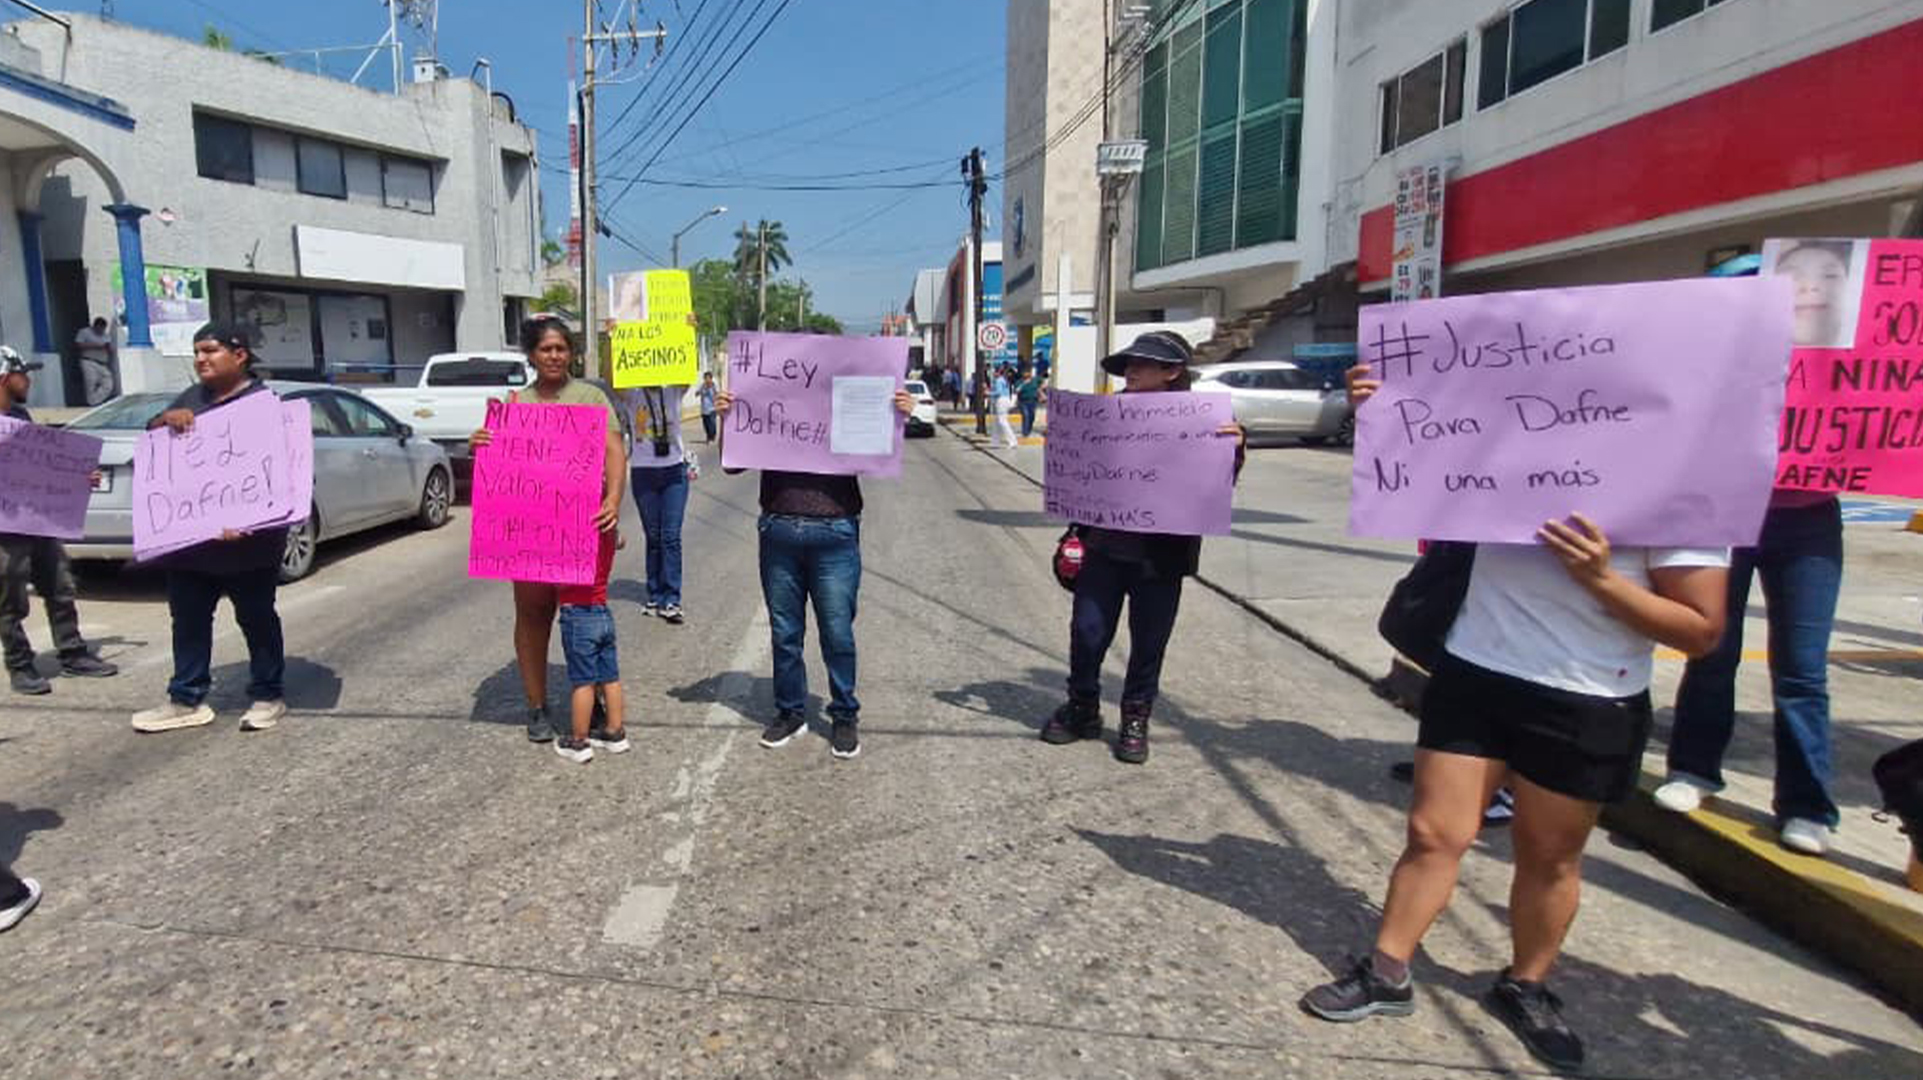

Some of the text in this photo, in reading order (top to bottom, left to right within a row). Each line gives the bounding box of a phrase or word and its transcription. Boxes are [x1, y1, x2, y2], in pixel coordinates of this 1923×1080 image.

[732, 338, 819, 390] #Ley
[1367, 318, 1616, 382] #Justicia
[1394, 388, 1633, 446] Para Dafne
[1374, 456, 1410, 491] Ni
[1443, 472, 1498, 493] una
